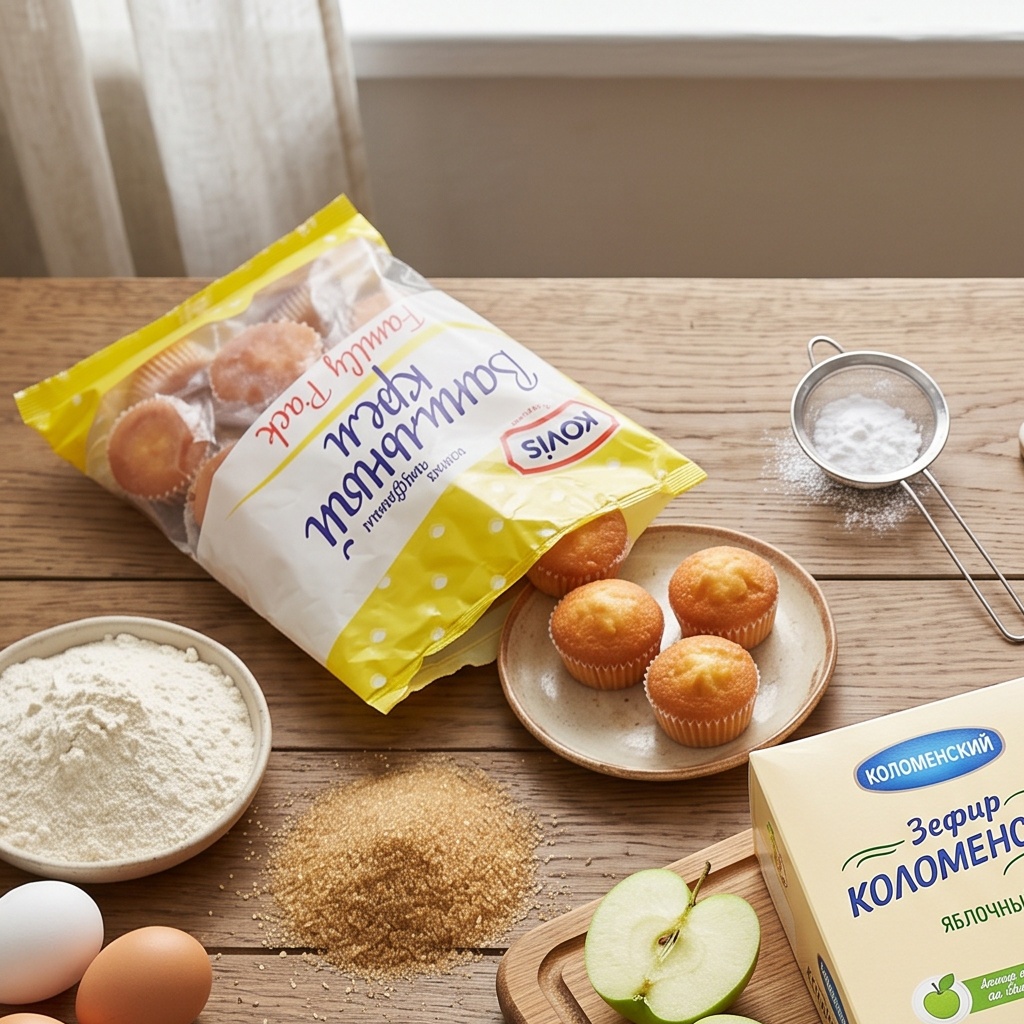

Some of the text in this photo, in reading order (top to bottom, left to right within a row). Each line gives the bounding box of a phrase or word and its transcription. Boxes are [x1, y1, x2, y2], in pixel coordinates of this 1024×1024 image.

[255, 387, 331, 448] Pack
[322, 363, 433, 452] крем
[304, 349, 538, 562] Ванильный
[865, 732, 995, 788] КОЛОМЕНСКИЙ
[906, 795, 1001, 847] Зефир
